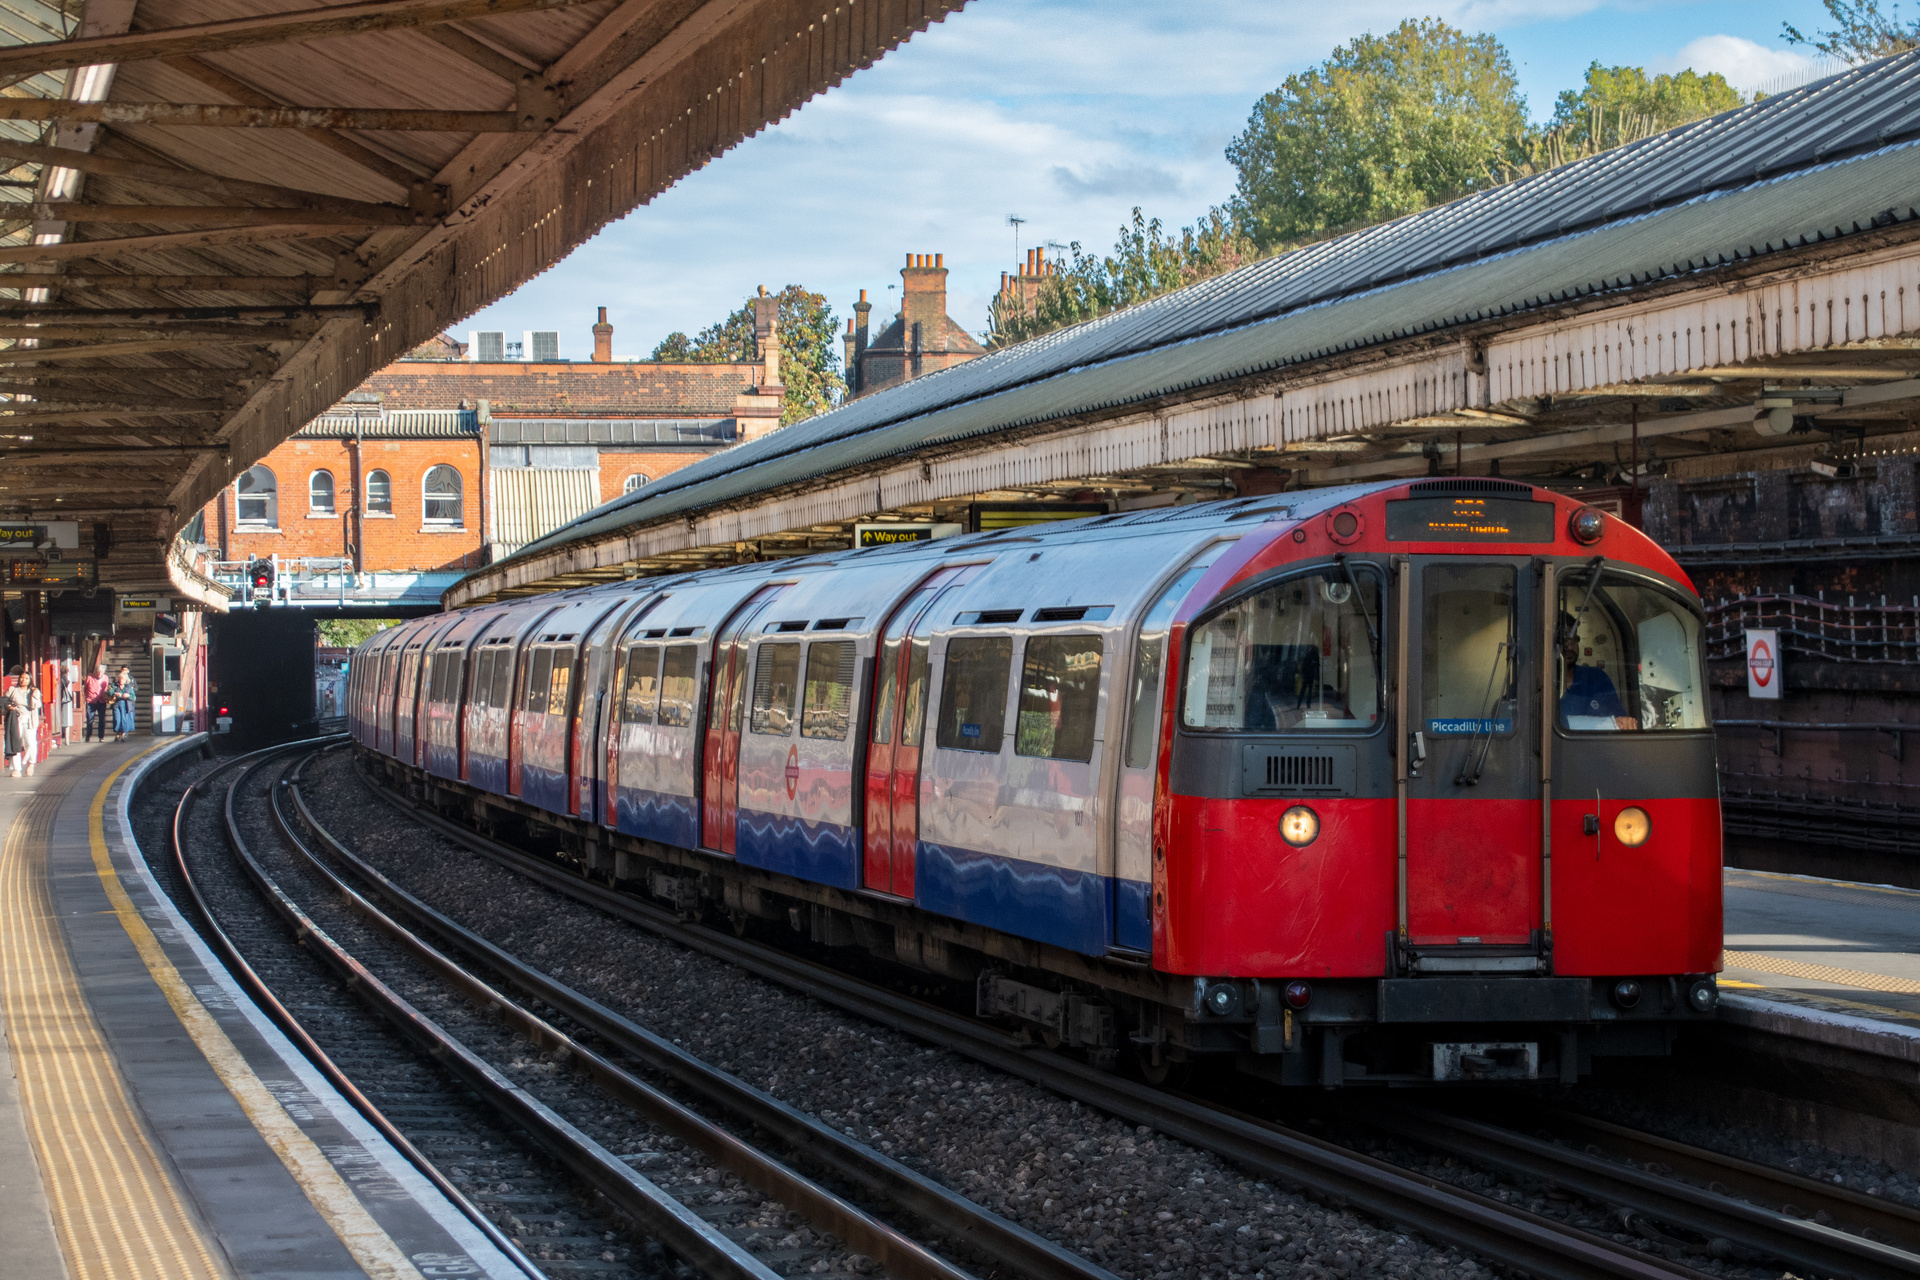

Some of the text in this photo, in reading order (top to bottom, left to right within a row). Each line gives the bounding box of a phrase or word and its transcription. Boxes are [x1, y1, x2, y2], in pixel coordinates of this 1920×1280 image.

[0, 528, 34, 539] ay out
[874, 531, 917, 543] Way out
[1432, 721, 1482, 733] Piccadilly
